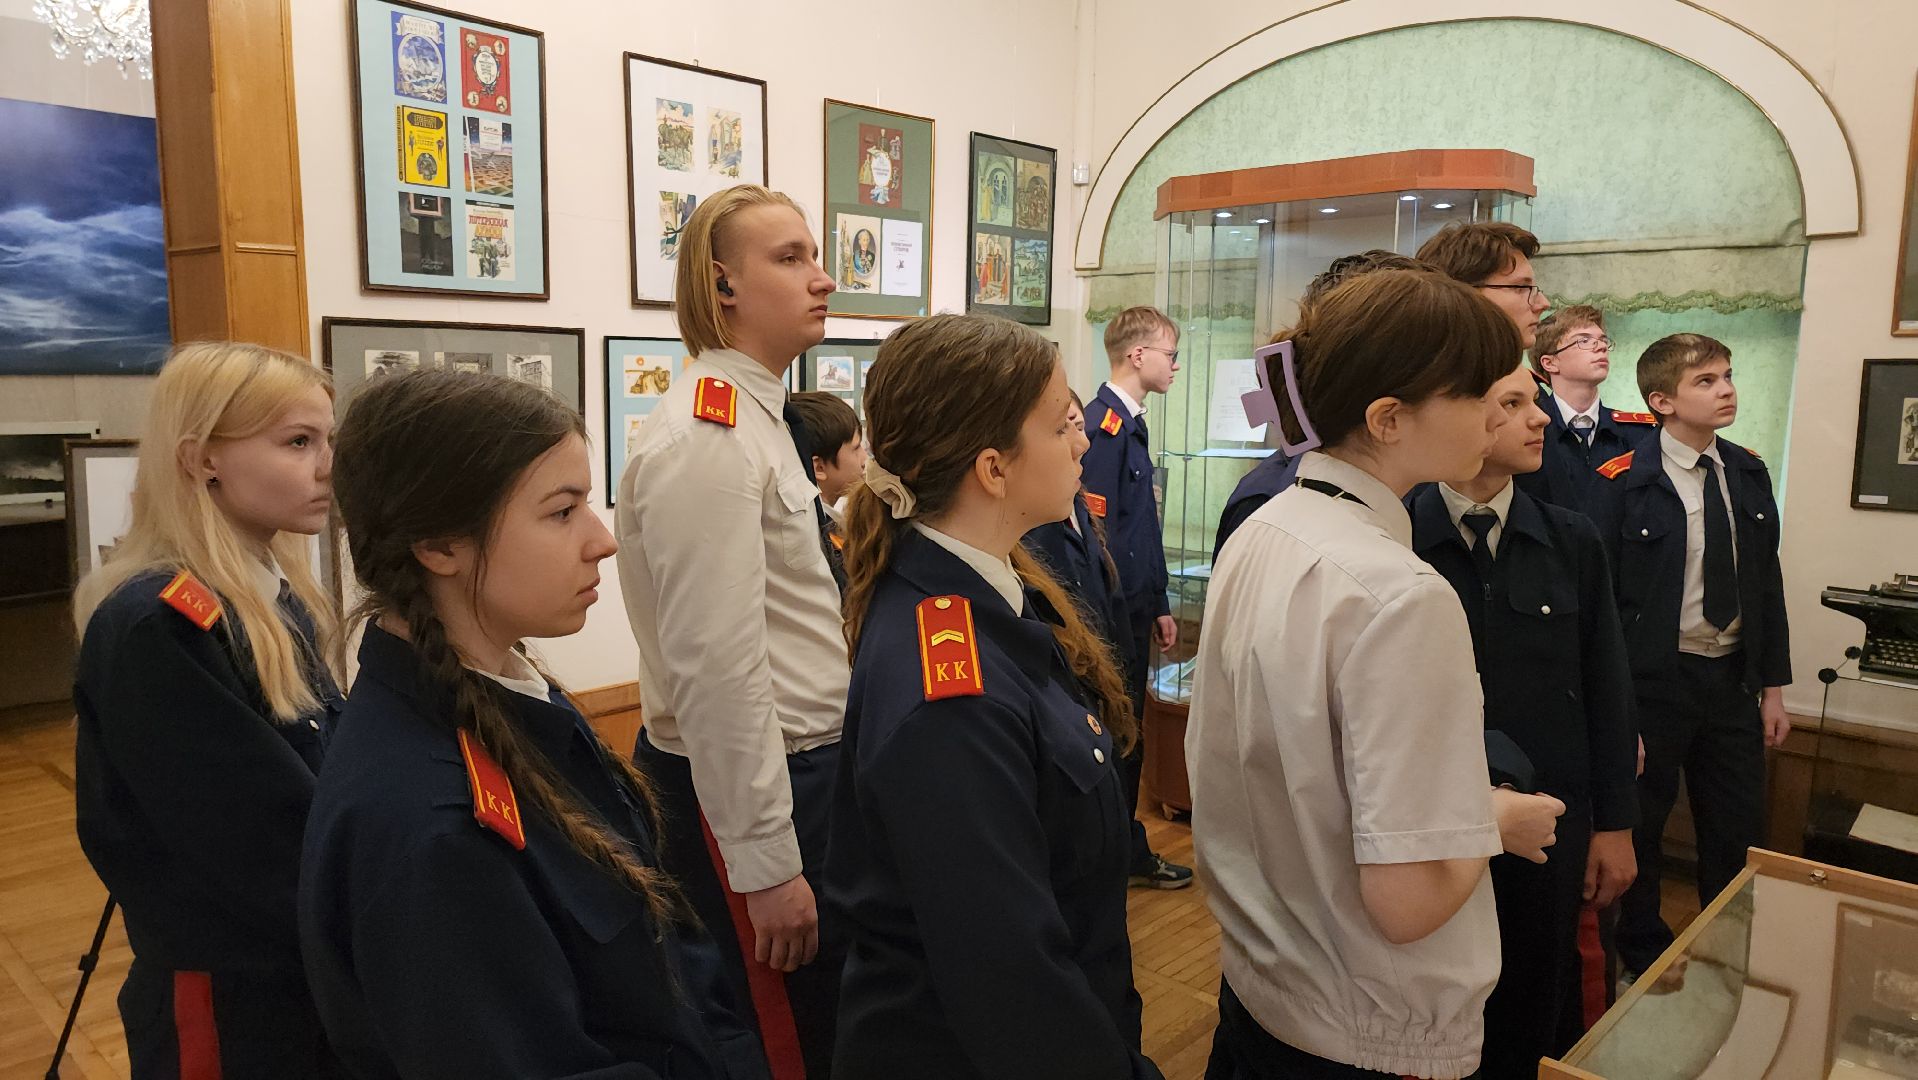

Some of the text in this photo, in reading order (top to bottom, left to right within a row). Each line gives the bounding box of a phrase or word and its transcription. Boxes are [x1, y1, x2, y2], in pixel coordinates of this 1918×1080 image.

[705, 405, 726, 418] КК
[181, 590, 208, 614] КК
[935, 660, 969, 682] КК
[485, 789, 515, 825] КК
